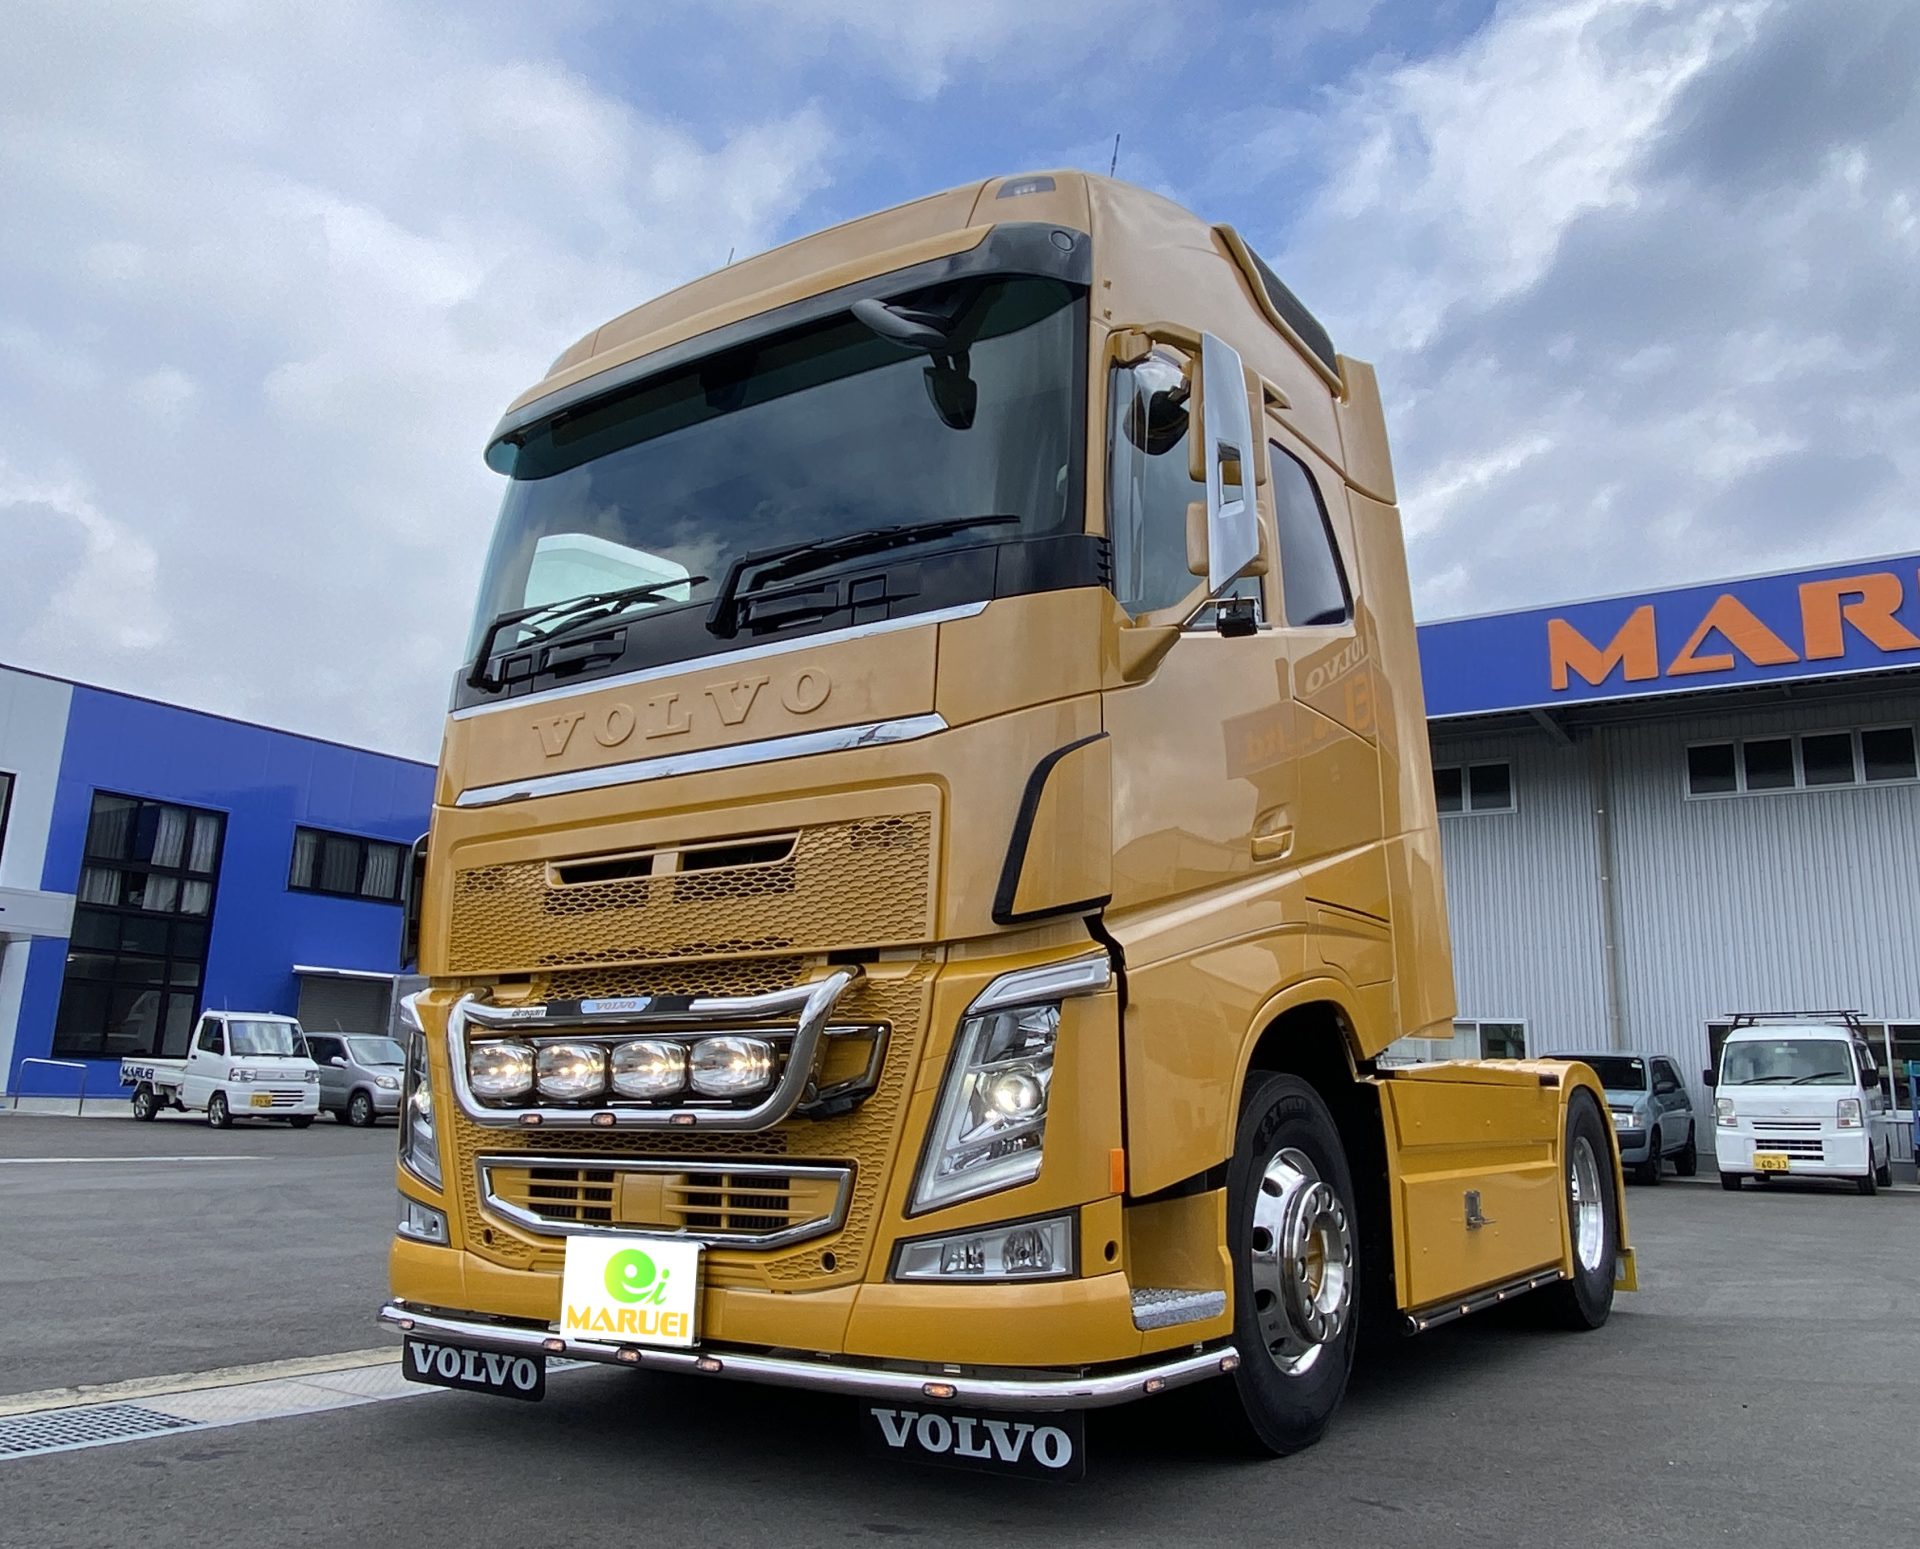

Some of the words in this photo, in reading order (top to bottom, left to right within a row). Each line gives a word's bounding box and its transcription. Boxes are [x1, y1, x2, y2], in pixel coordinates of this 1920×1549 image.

[1547, 570, 1920, 692] MAR
[531, 667, 832, 758] VOLVO
[595, 1001, 637, 1011] VOLVO
[566, 1304, 689, 1338] MARUEI
[408, 1342, 538, 1391] VOLVO
[871, 1408, 1074, 1468] VOLVO
